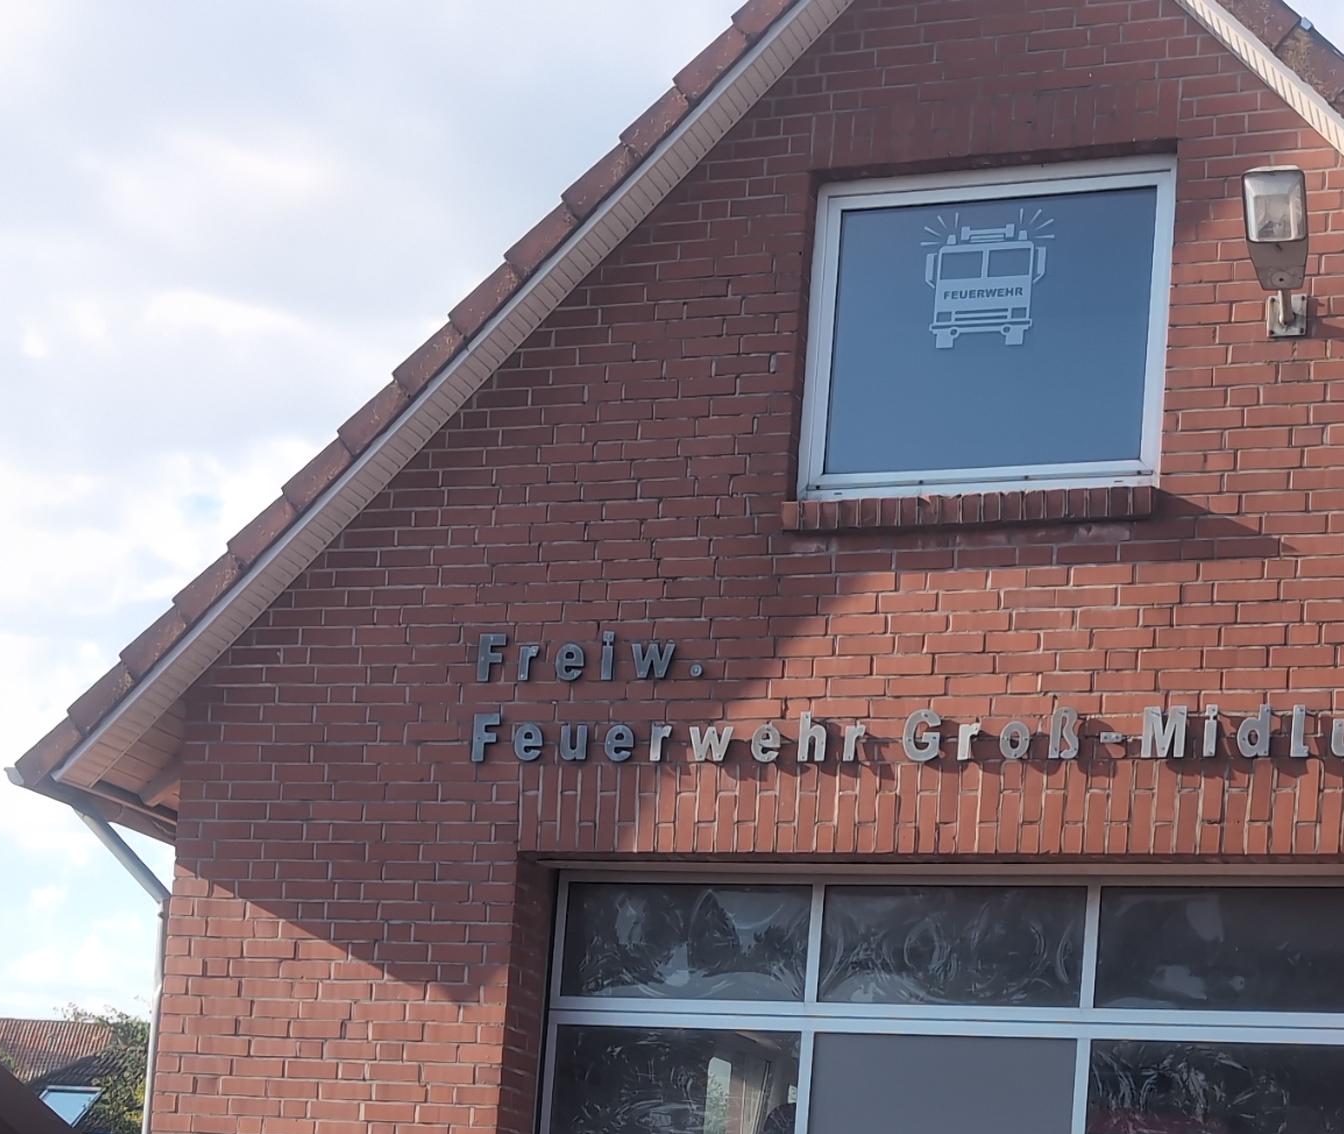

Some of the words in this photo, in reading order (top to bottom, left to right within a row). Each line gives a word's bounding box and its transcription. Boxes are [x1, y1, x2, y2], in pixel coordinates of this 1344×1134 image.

[943, 287, 1023, 300] FEUERWEHR
[476, 630, 704, 682] Freiw.
[471, 711, 866, 762] Feuerwehr
